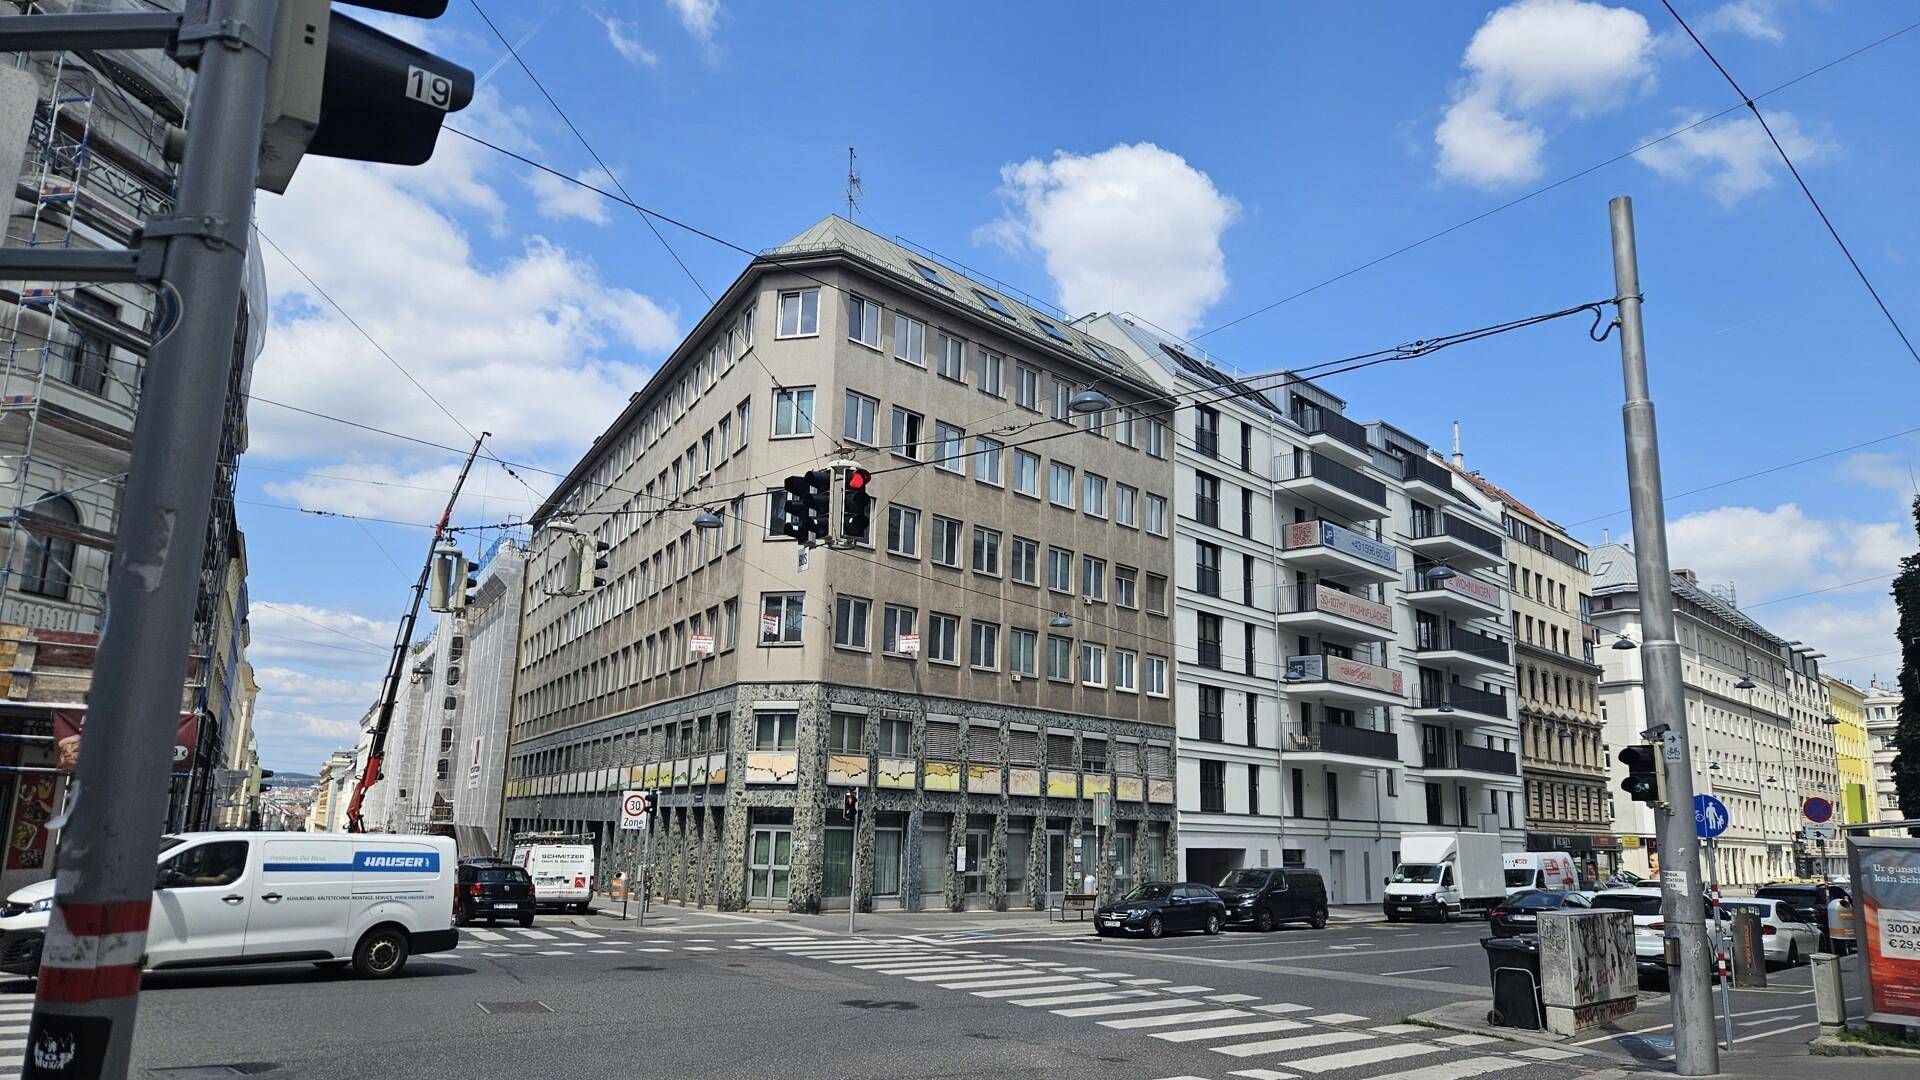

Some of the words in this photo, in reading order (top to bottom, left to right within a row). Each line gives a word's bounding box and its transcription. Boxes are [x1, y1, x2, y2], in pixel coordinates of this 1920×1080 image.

[412, 70, 450, 106] 19
[630, 800, 641, 811] 30
[623, 817, 644, 827] Zone
[364, 856, 423, 868] HAUSER
[1873, 864, 1885, 872] Ur
[1874, 874, 1898, 883] kein
[1887, 924, 1909, 934] 300
[1889, 938, 1898, 948] €
